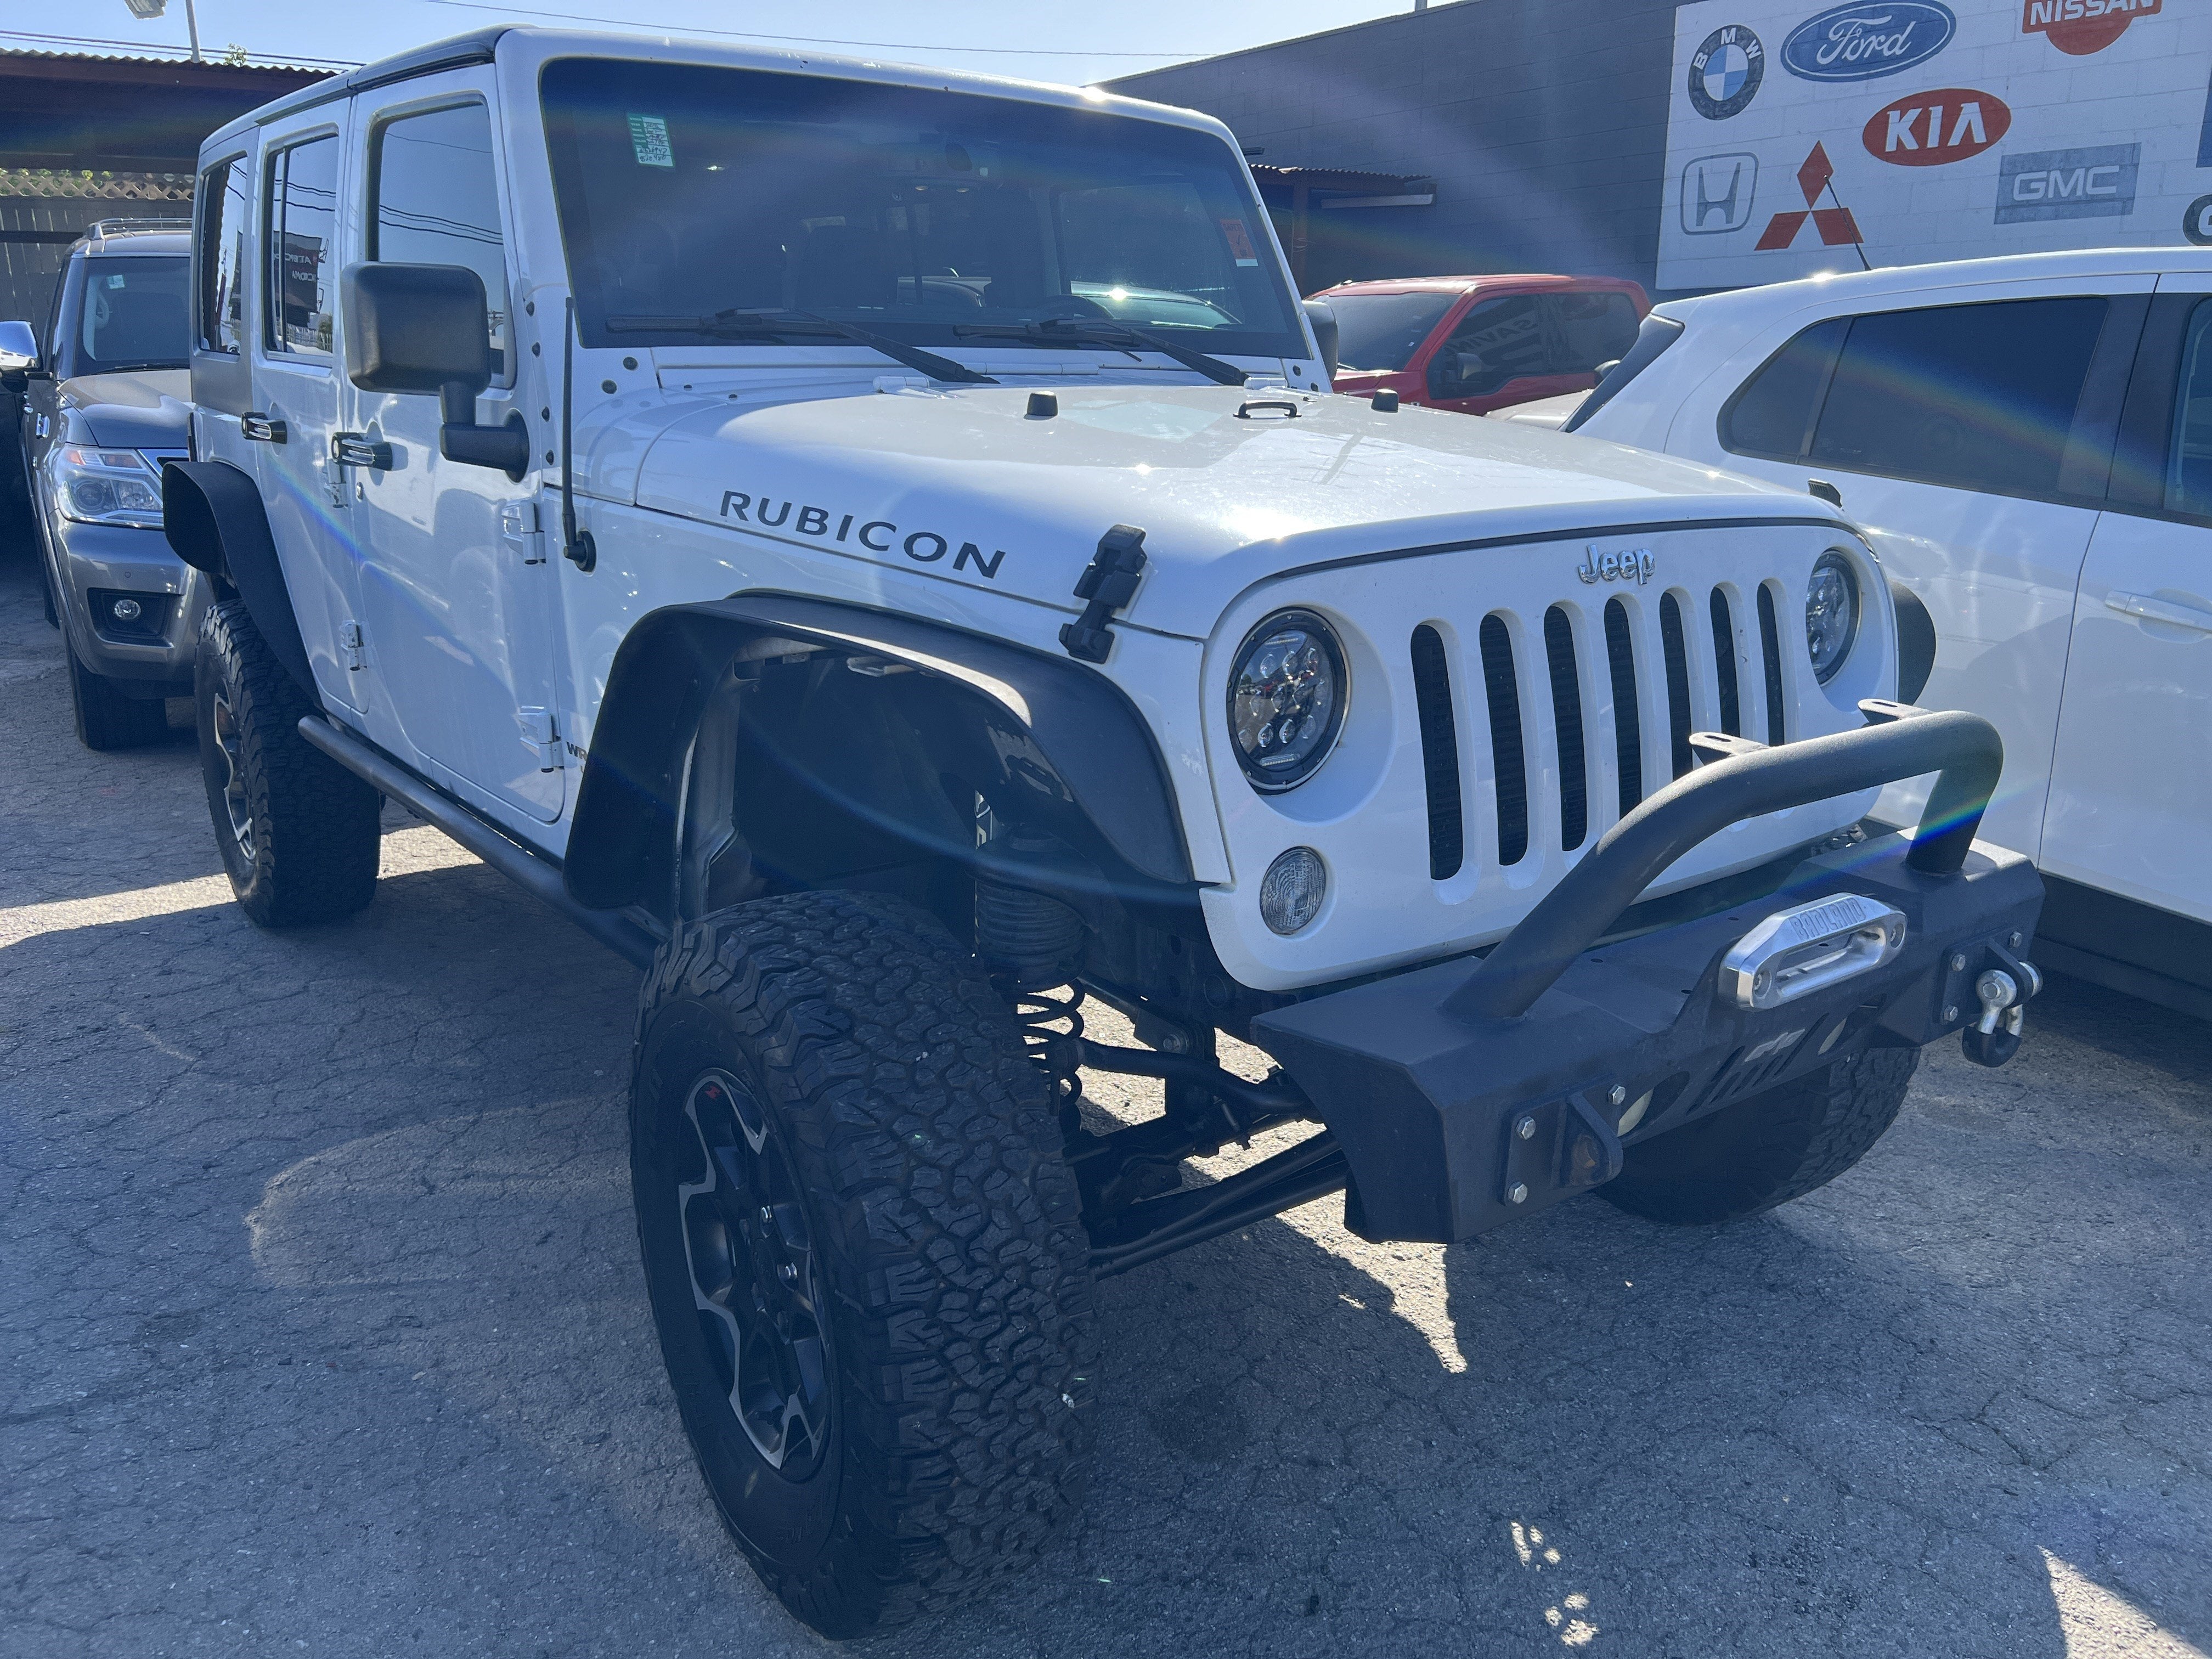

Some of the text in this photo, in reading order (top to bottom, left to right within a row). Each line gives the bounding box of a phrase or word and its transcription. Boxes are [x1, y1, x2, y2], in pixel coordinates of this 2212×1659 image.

[1693, 27, 1762, 70] BMW
[1816, 15, 1916, 65] Ford
[1885, 101, 1988, 153] KIA
[2013, 165, 2119, 201] GMC
[720, 490, 1006, 579] RUBICON
[1578, 544, 1655, 585] Jeep
[1789, 897, 1866, 941] BADLAND
